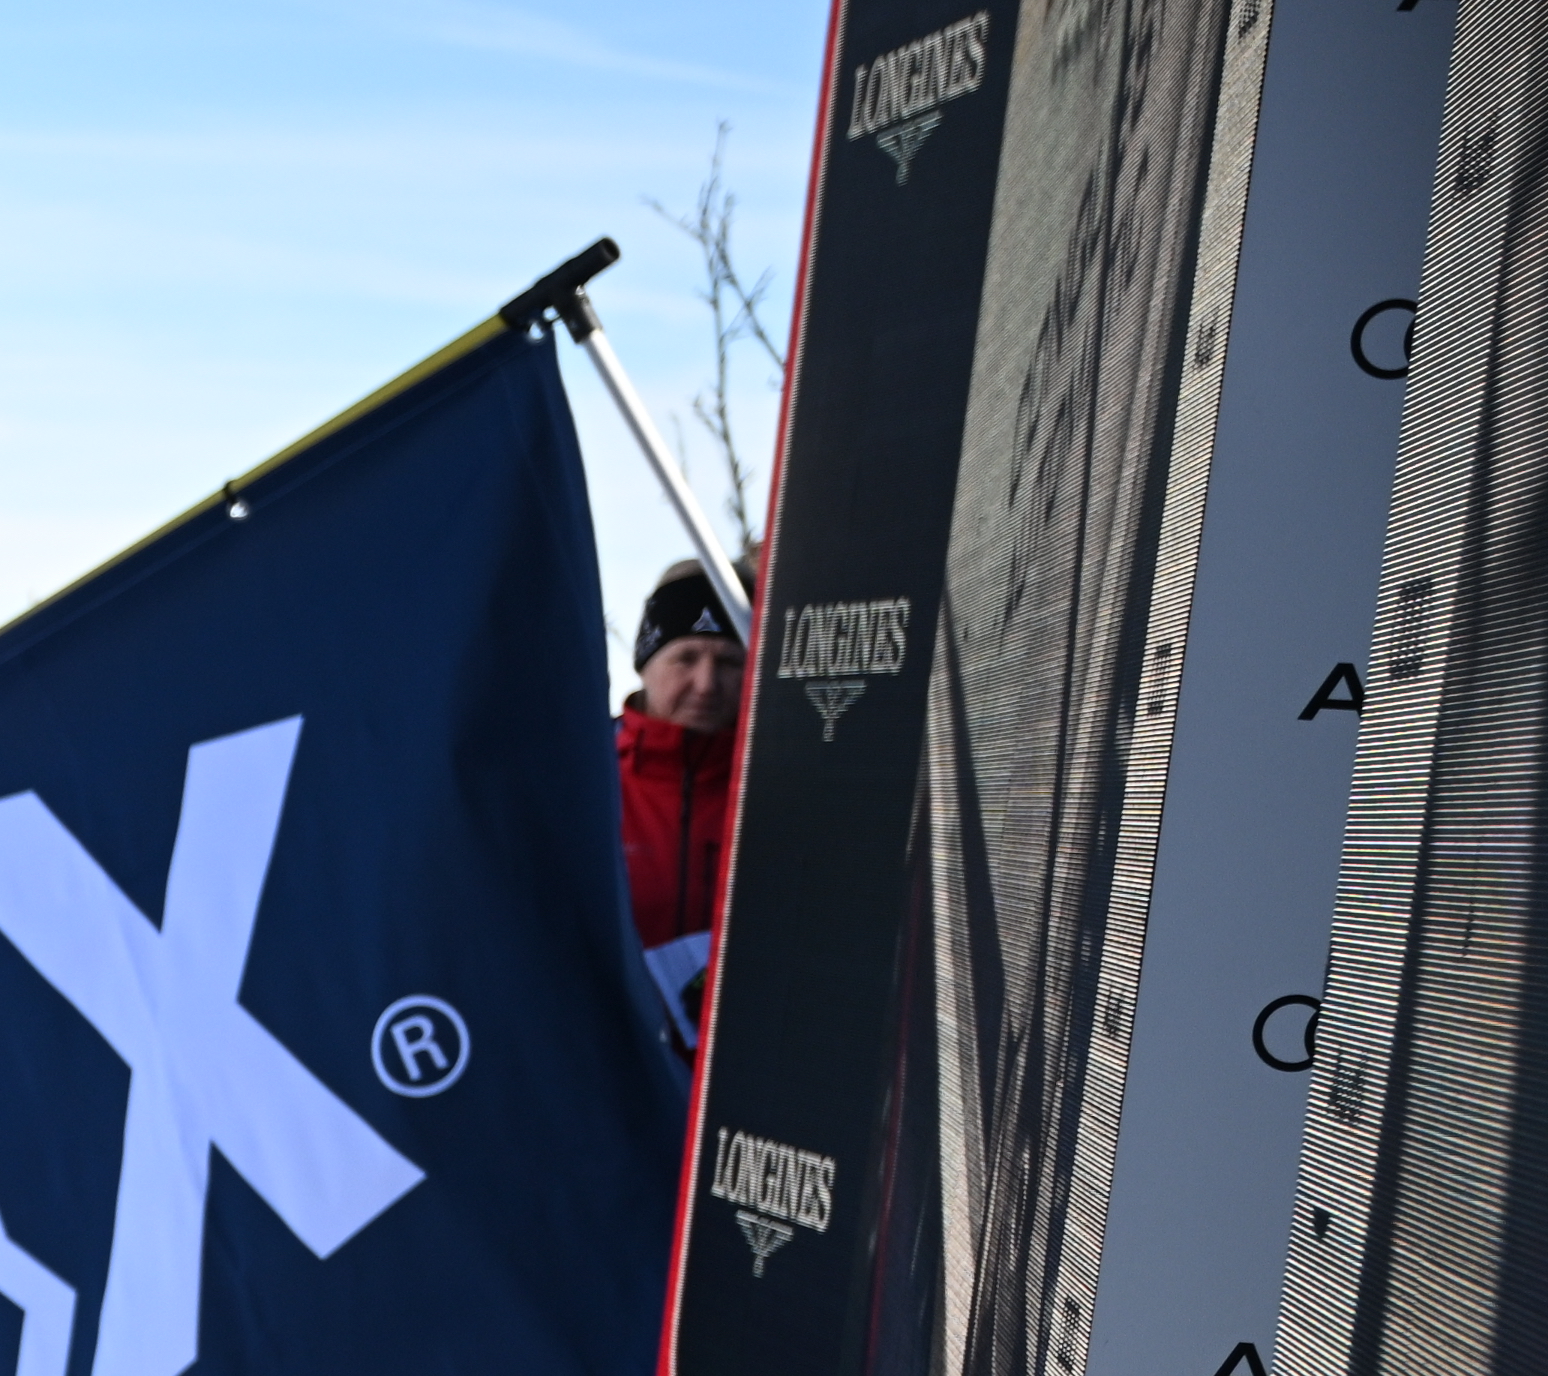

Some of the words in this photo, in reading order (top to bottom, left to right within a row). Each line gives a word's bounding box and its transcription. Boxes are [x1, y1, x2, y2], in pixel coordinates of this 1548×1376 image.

[846, 8, 989, 142] LONGINES
[777, 597, 911, 680] LONGINES
[710, 1125, 837, 1236] LONGINES
